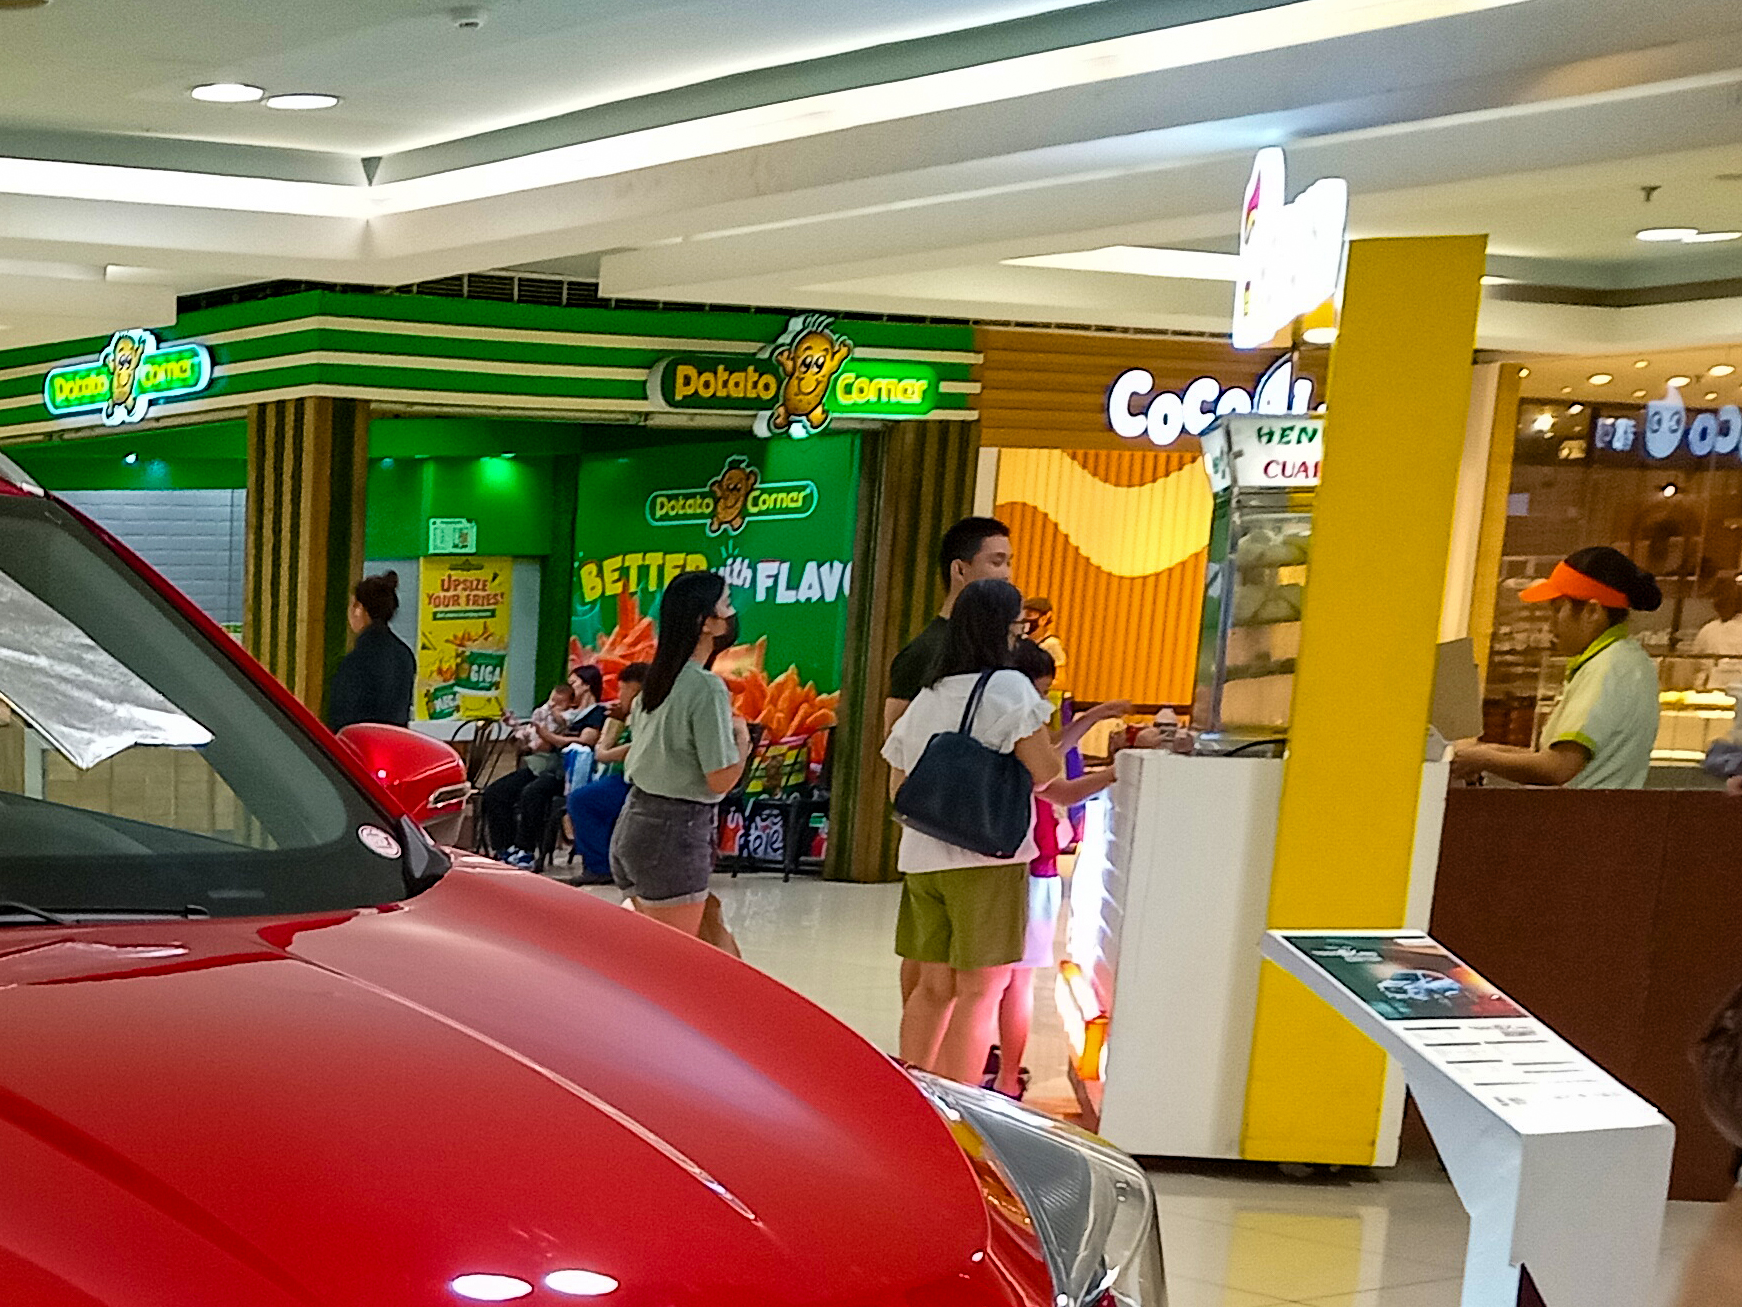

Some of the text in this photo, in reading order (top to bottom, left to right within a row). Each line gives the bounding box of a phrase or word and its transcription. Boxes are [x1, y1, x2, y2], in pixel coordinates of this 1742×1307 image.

[674, 364, 928, 405] Potato Corner
[654, 489, 807, 519] Potato Corner
[441, 573, 489, 593] UPSIZE
[426, 591, 505, 608] YOUR FRIES!
[470, 664, 501, 683] GIGA
